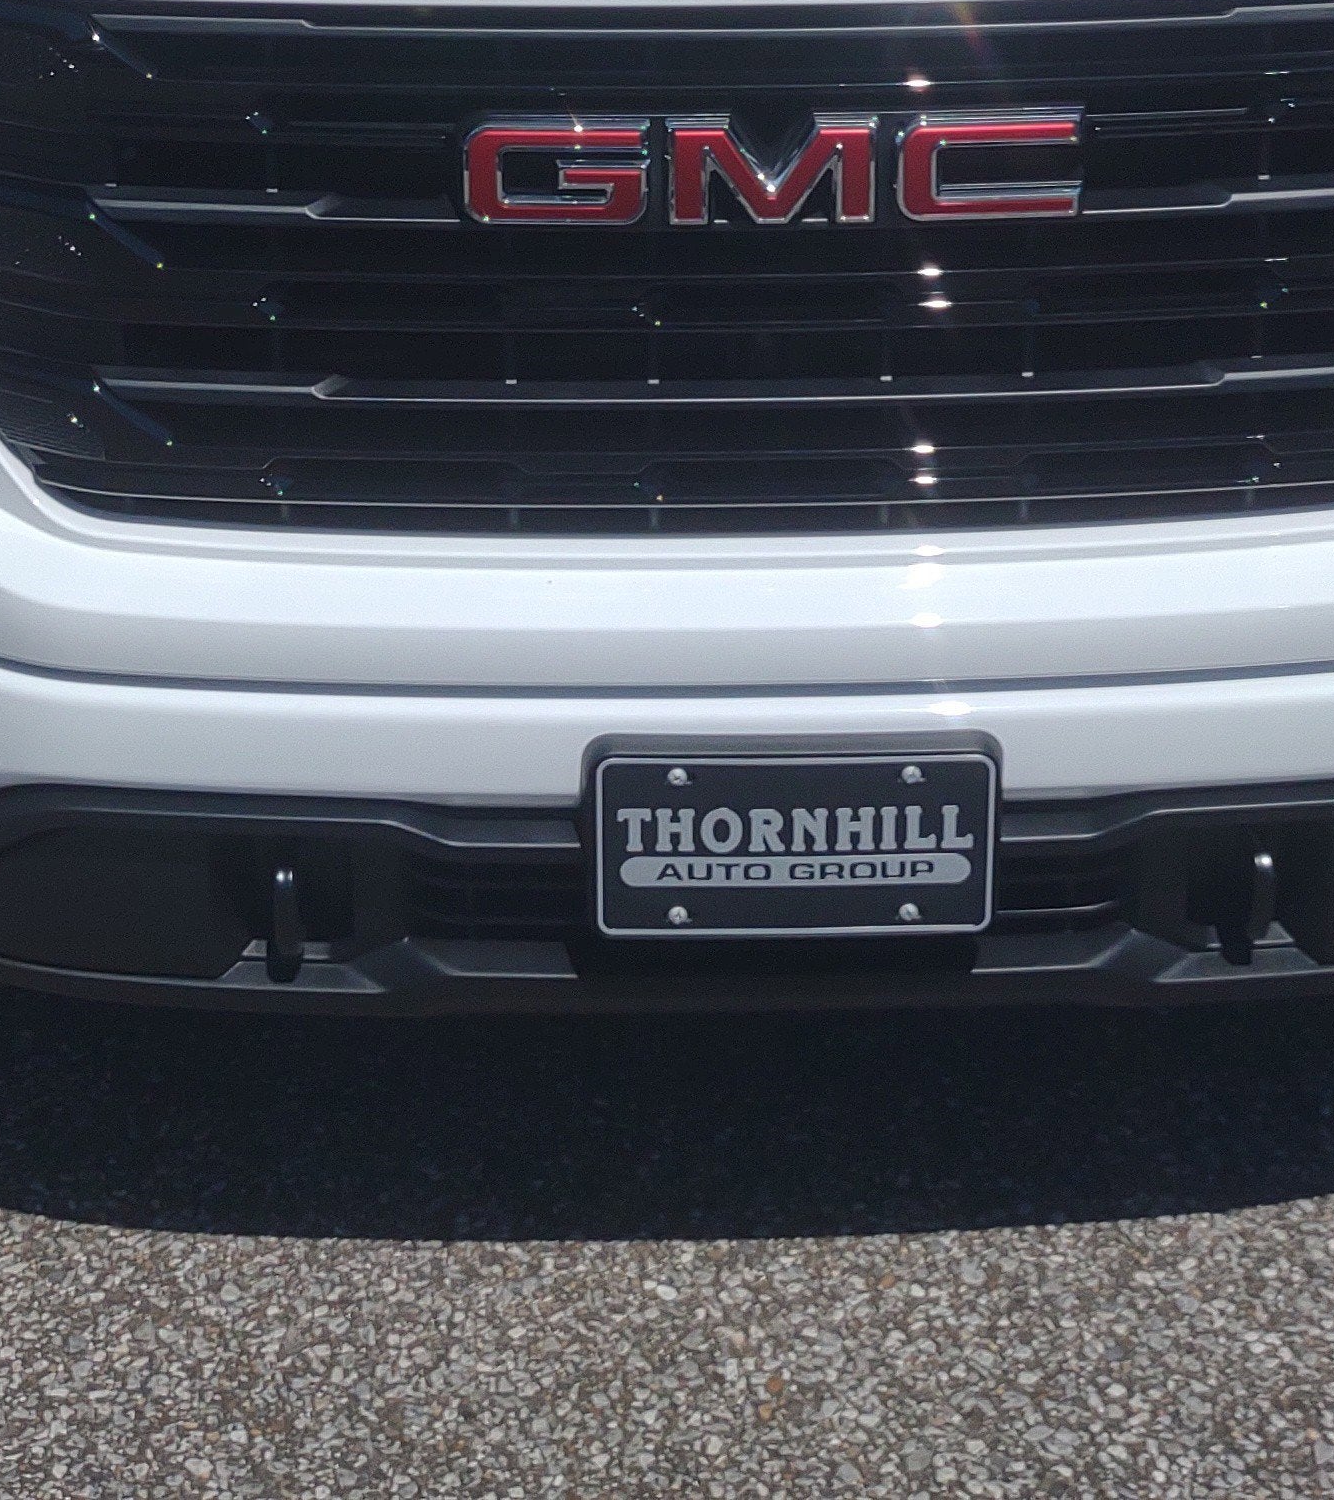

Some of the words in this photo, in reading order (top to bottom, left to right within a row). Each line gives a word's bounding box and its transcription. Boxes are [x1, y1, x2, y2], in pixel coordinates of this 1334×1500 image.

[464, 106, 1084, 225] GMC
[617, 805, 974, 853] THORNHILL
[656, 862, 772, 882] AUTO
[789, 859, 935, 880] GROUP
